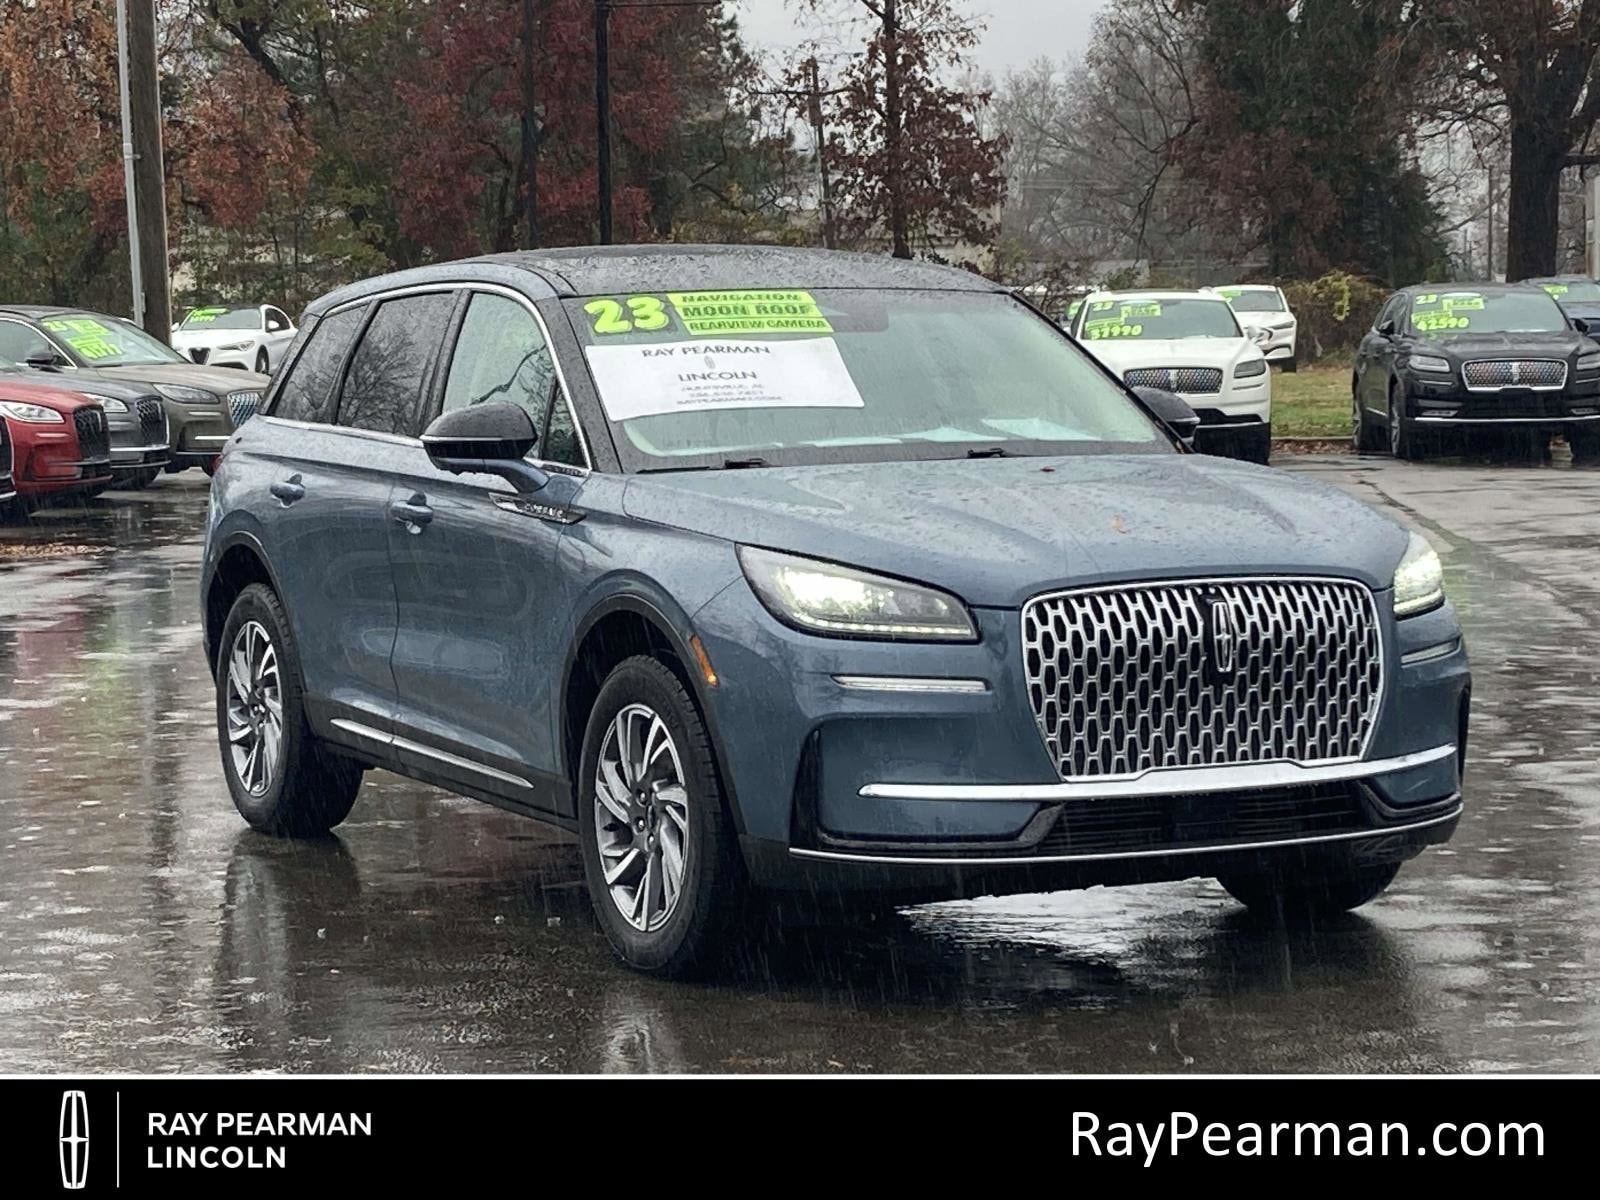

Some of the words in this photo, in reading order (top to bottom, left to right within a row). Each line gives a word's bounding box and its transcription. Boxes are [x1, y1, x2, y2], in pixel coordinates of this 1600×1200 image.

[682, 292, 802, 303] NAVIGATION
[584, 296, 669, 333] 23
[682, 304, 747, 317] MOON
[755, 303, 810, 315] ROOF
[690, 319, 764, 331] REARVIEW
[766, 318, 826, 329] CAMERA
[642, 347, 675, 358] RAY
[681, 344, 771, 356] PEARMAN
[678, 370, 759, 382] LINCOLN
